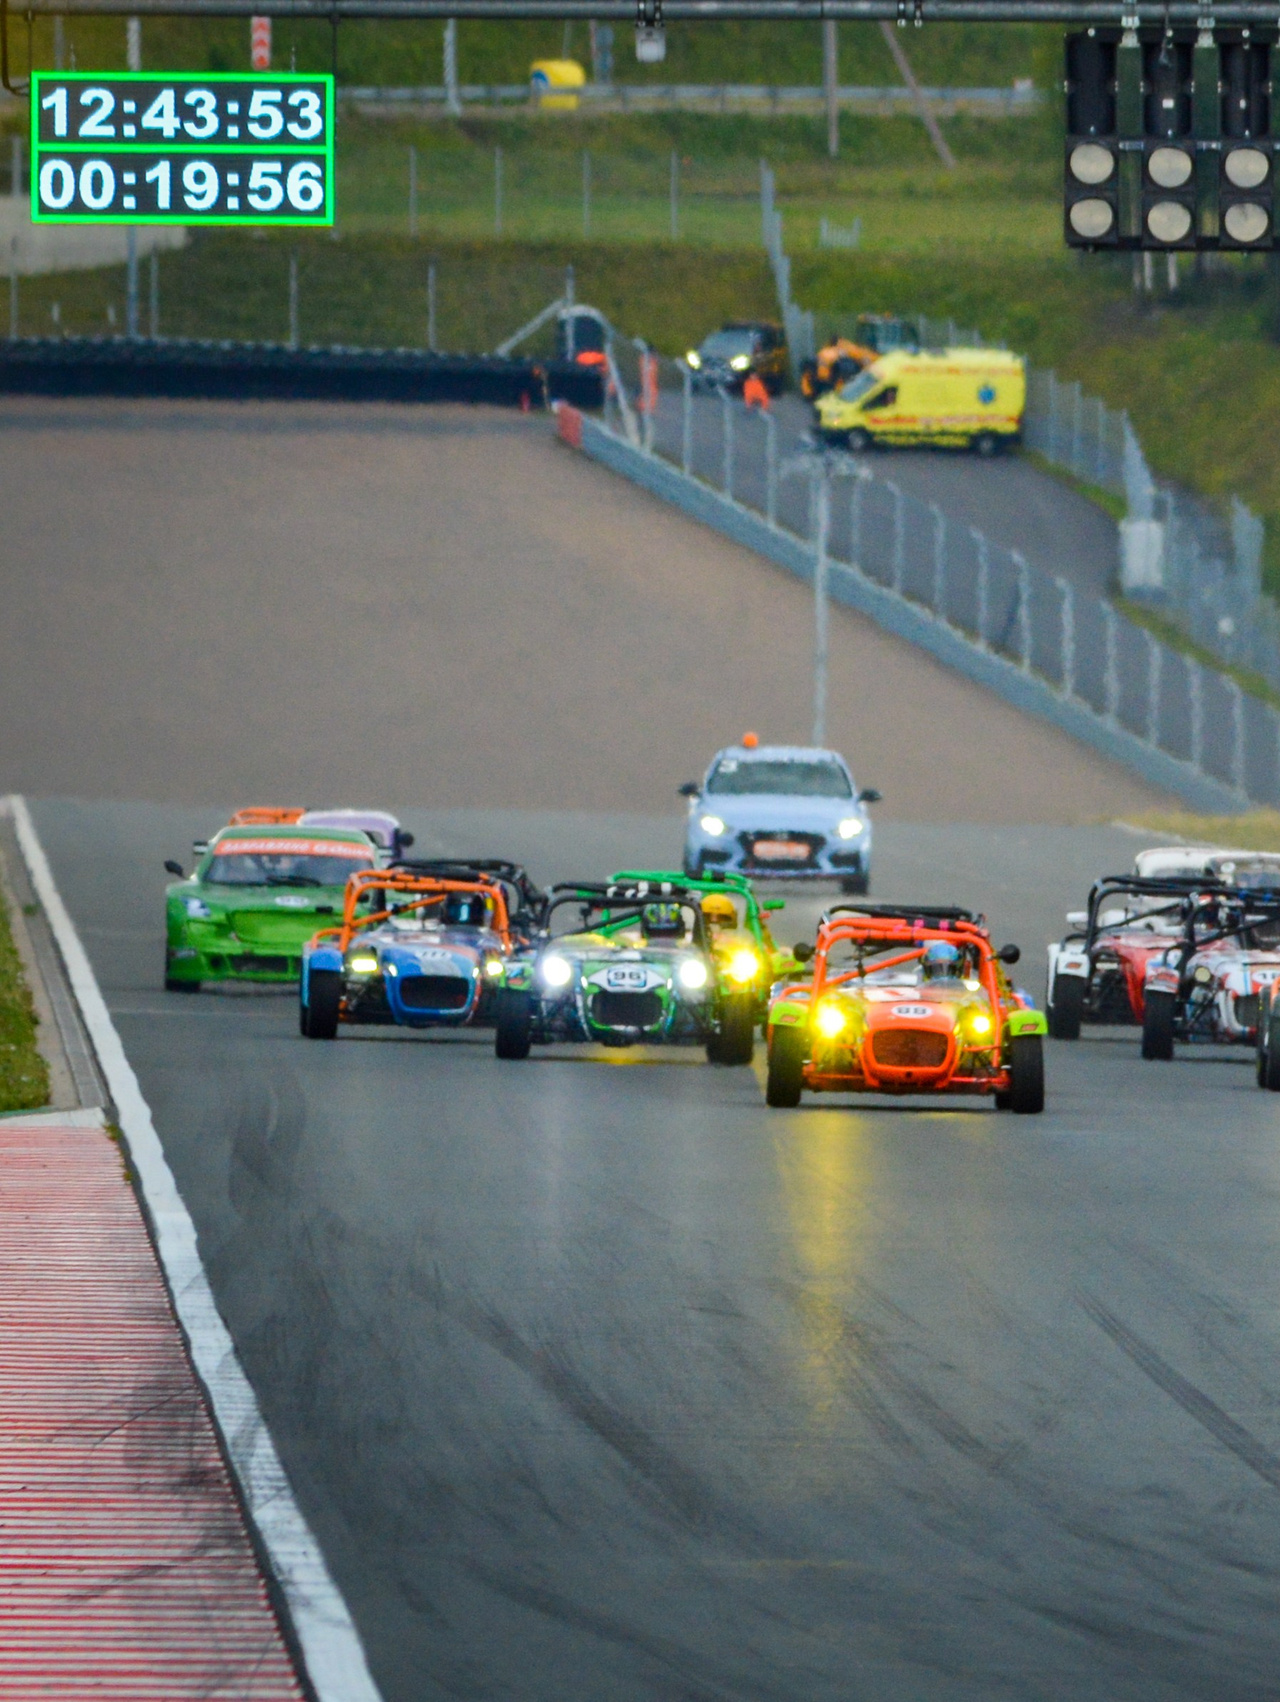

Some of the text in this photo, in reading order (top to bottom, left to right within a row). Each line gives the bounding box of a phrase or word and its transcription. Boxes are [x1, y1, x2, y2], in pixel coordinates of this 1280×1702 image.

[42, 87, 322, 139] 12:43:53
[39, 159, 323, 210] 00:19:56
[614, 971, 641, 980] 96
